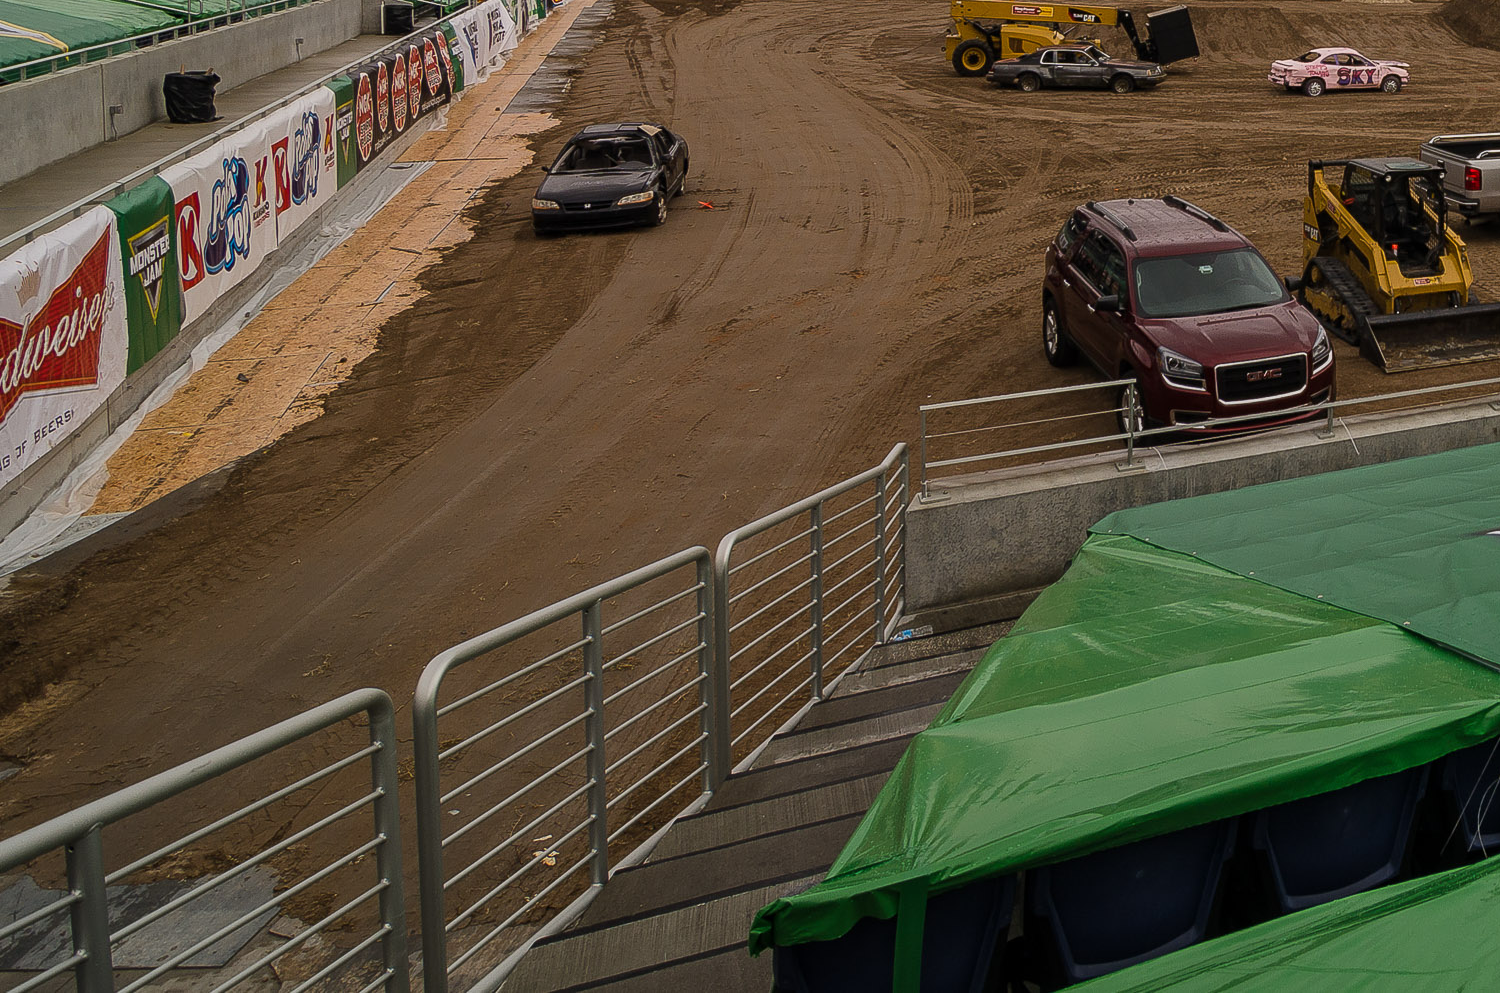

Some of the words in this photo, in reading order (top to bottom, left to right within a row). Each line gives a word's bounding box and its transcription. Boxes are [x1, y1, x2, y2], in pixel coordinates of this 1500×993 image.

[1083, 14, 1095, 22] CAT
[1336, 67, 1376, 85] SKY
[225, 196, 250, 268] POP
[1310, 227, 1319, 241] CAT
[130, 233, 171, 277] MONSTER
[143, 262, 163, 287] JAM
[0, 281, 116, 395] dweiser
[1246, 368, 1282, 382] GMC
